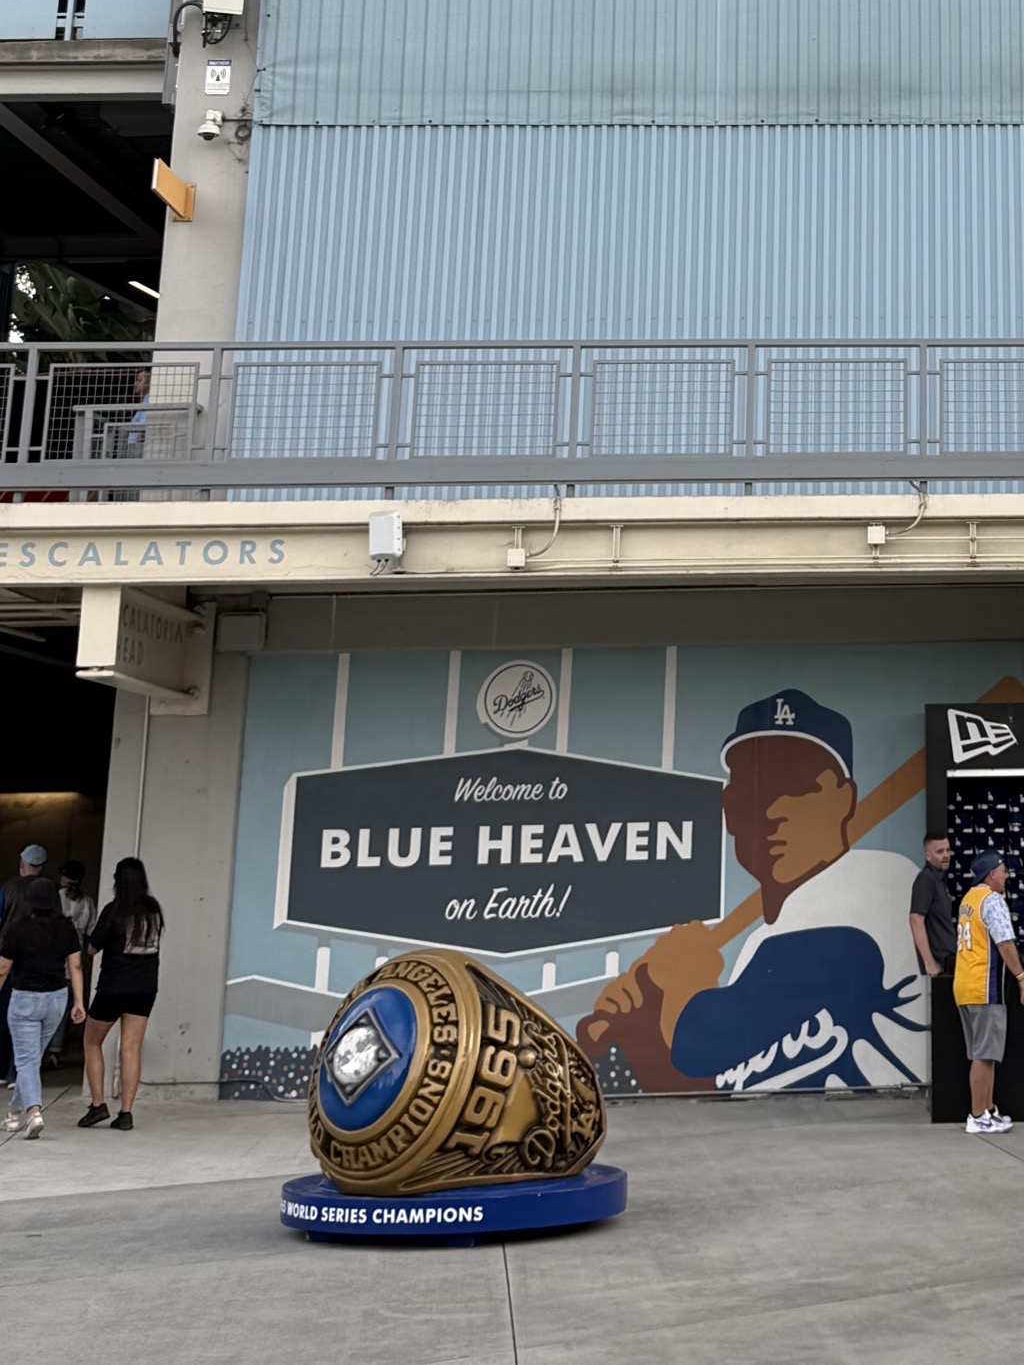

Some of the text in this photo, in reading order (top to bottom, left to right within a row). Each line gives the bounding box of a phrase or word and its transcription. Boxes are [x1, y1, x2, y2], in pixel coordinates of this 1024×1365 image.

[493, 684, 545, 715] Dodgers
[774, 698, 795, 725] LA
[454, 776, 569, 803] Welcome to
[320, 820, 694, 868] BLUE HEAVEN
[444, 884, 572, 920] on Earth!
[443, 1004, 521, 1158] 1965
[330, 1058, 452, 1170] CHAMPIONS
[287, 1201, 318, 1221] WORLD
[320, 1207, 367, 1224] SERIES
[372, 1206, 484, 1224] CHAMPIONS
